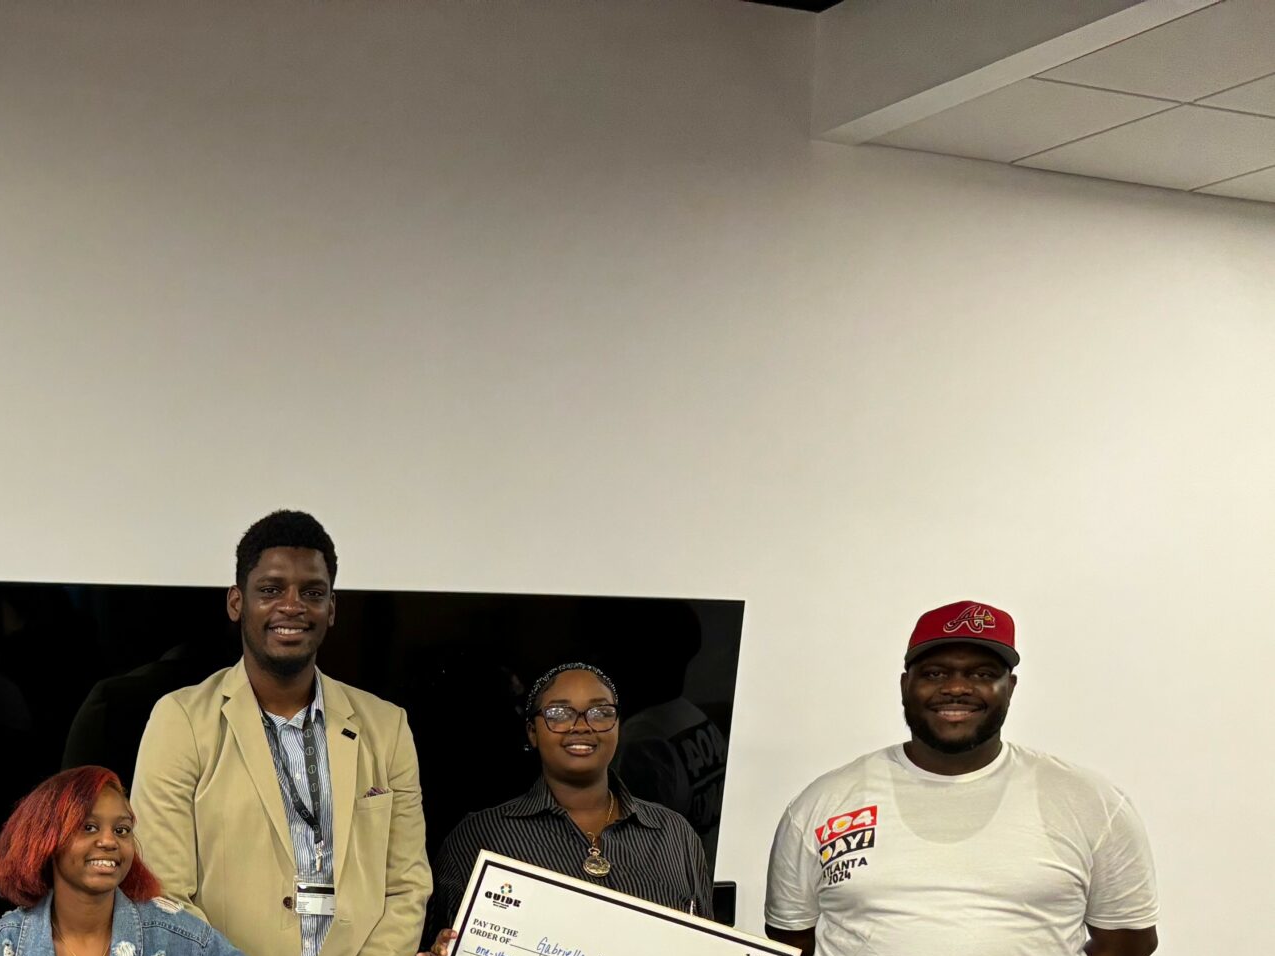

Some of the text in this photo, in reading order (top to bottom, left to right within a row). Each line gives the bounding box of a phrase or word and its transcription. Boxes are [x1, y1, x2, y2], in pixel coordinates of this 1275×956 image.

[820, 830, 872, 864] DAY!
[823, 857, 868, 880] ATLANTA
[827, 871, 852, 885] 2024
[484, 890, 522, 908] GUIDE
[470, 928, 512, 945] ORDER OF
[473, 918, 519, 938] PAY TO THE
